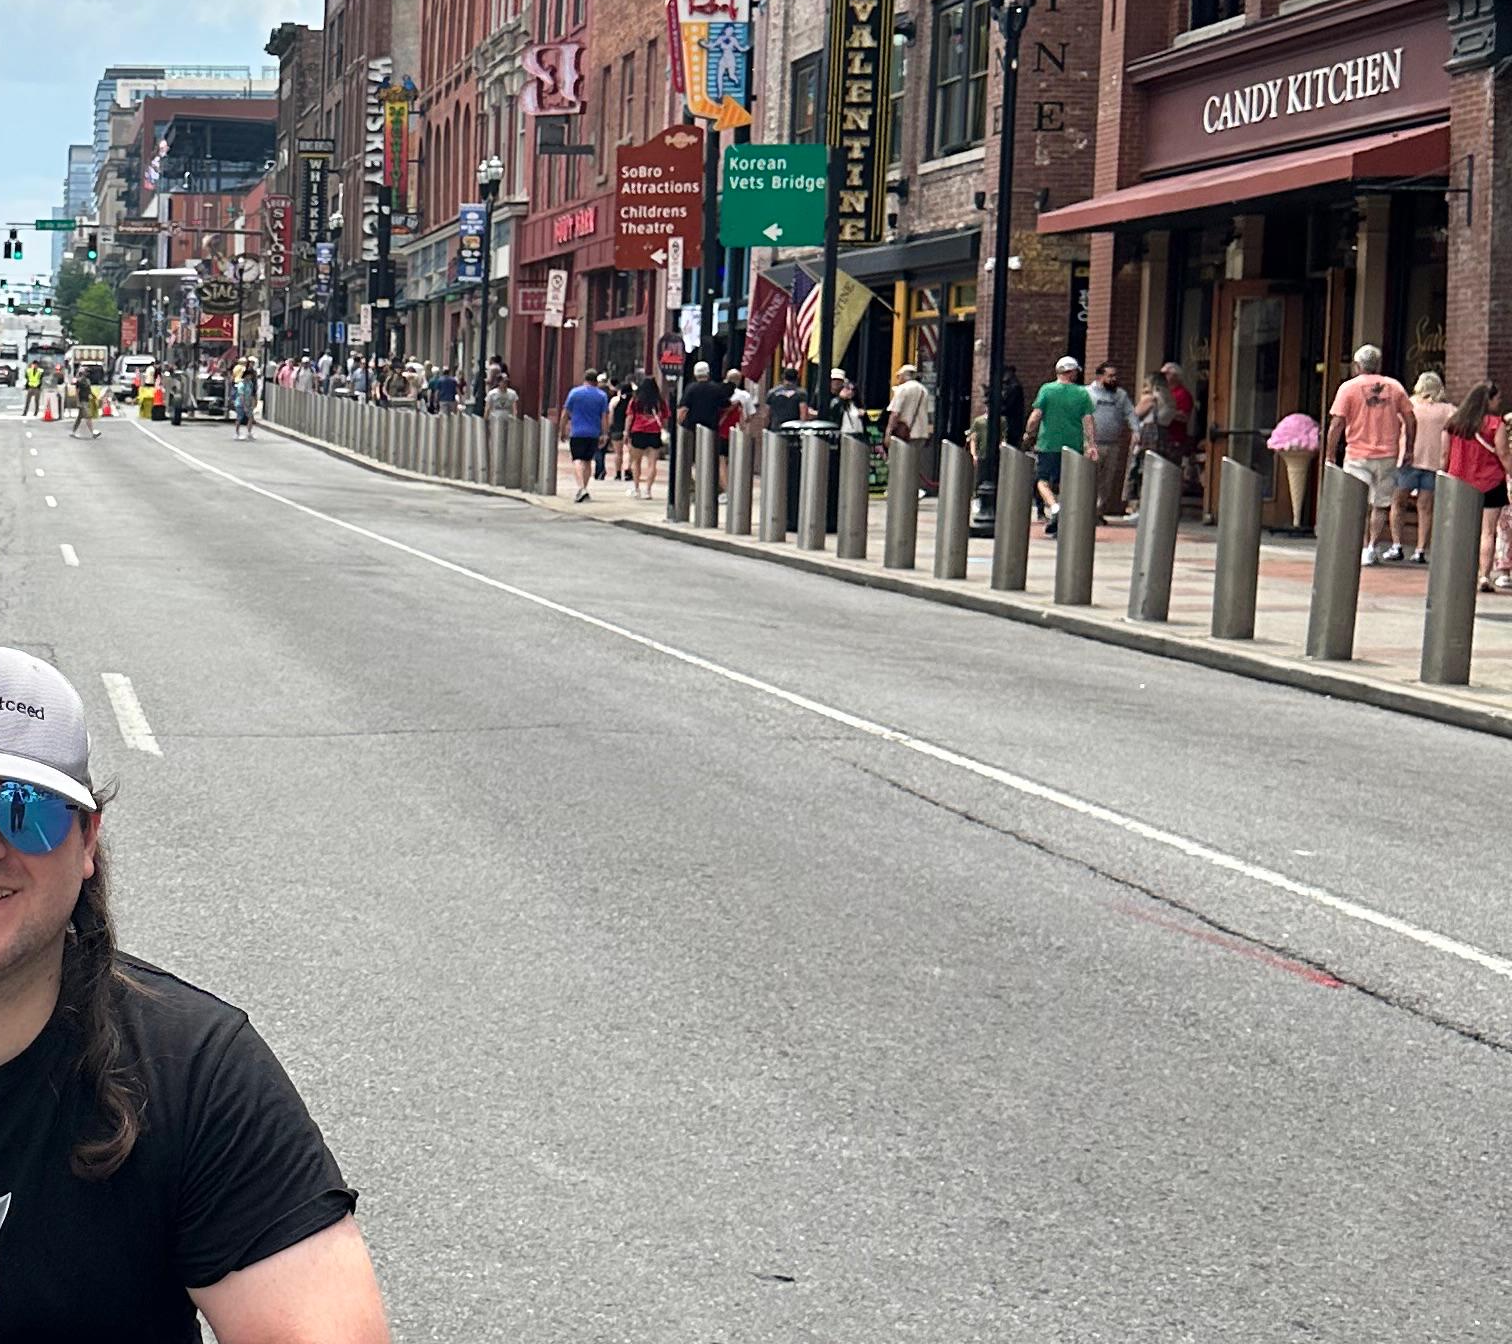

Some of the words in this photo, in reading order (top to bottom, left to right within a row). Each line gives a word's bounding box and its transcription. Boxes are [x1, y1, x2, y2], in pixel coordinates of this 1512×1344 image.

[1202, 78, 1285, 135] CANDY
[1285, 47, 1405, 115] KITCHEN
[620, 165, 663, 178] SoBro
[729, 157, 787, 171] Korean
[620, 179, 700, 195] Attractions
[729, 176, 765, 190] Vets
[771, 174, 826, 193] Bridge
[308, 158, 323, 243] WHISKEY
[620, 205, 688, 219] Childrens
[620, 221, 675, 235] Theatre
